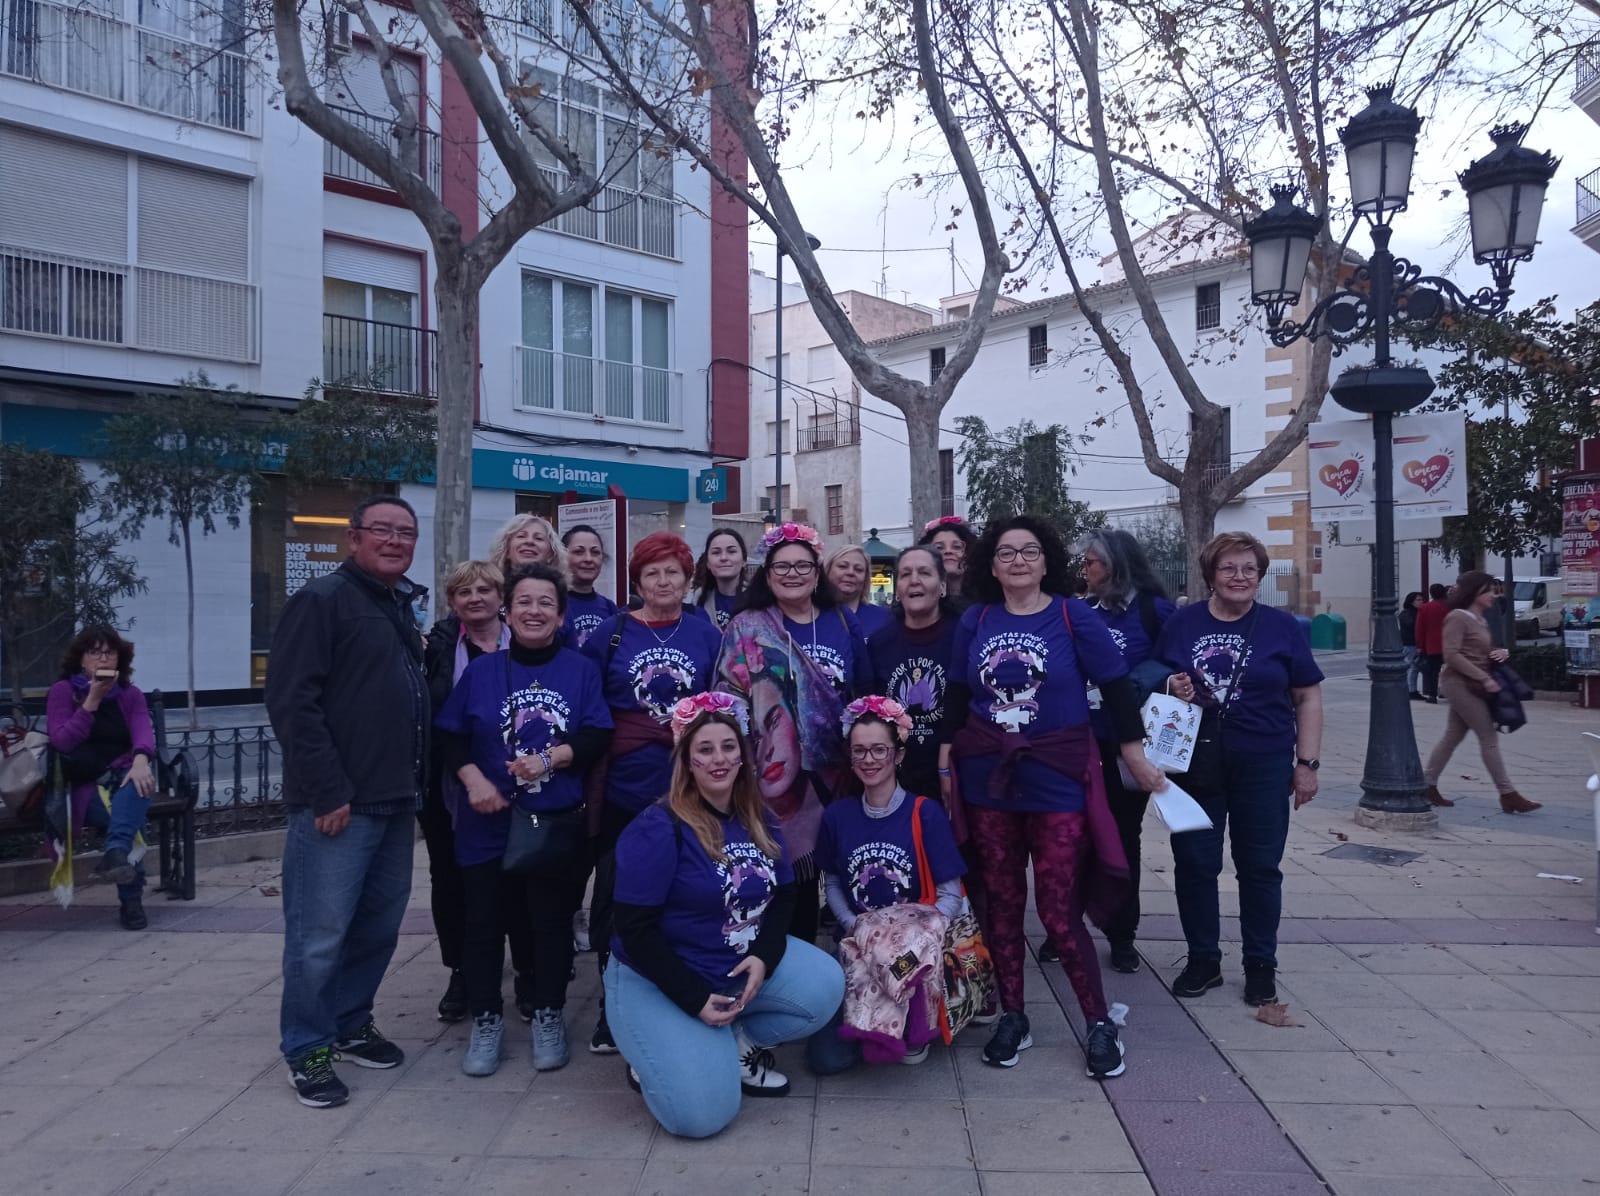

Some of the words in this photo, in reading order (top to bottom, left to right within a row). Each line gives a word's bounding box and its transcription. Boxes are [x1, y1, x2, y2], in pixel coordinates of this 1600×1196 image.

[540, 464, 608, 484] cajamar
[1324, 468, 1352, 482] Lorca
[1408, 465, 1440, 478] Lorca
[286, 543, 310, 552] NOS
[314, 544, 337, 553] UNE
[286, 552, 306, 561] SER
[286, 570, 310, 579] NOS
[988, 632, 1018, 643] JUNTAS
[634, 648, 662, 660] JUNTAS
[664, 648, 688, 660] SOMOS
[979, 638, 1049, 658] IMPARABLES
[628, 653, 696, 674] IMPARABLES
[892, 663, 908, 680] POR
[918, 657, 934, 669] POR
[852, 842, 880, 856] JUNTAS
[882, 842, 906, 856] SOMOS
[848, 849, 912, 874] IMPARABLES
